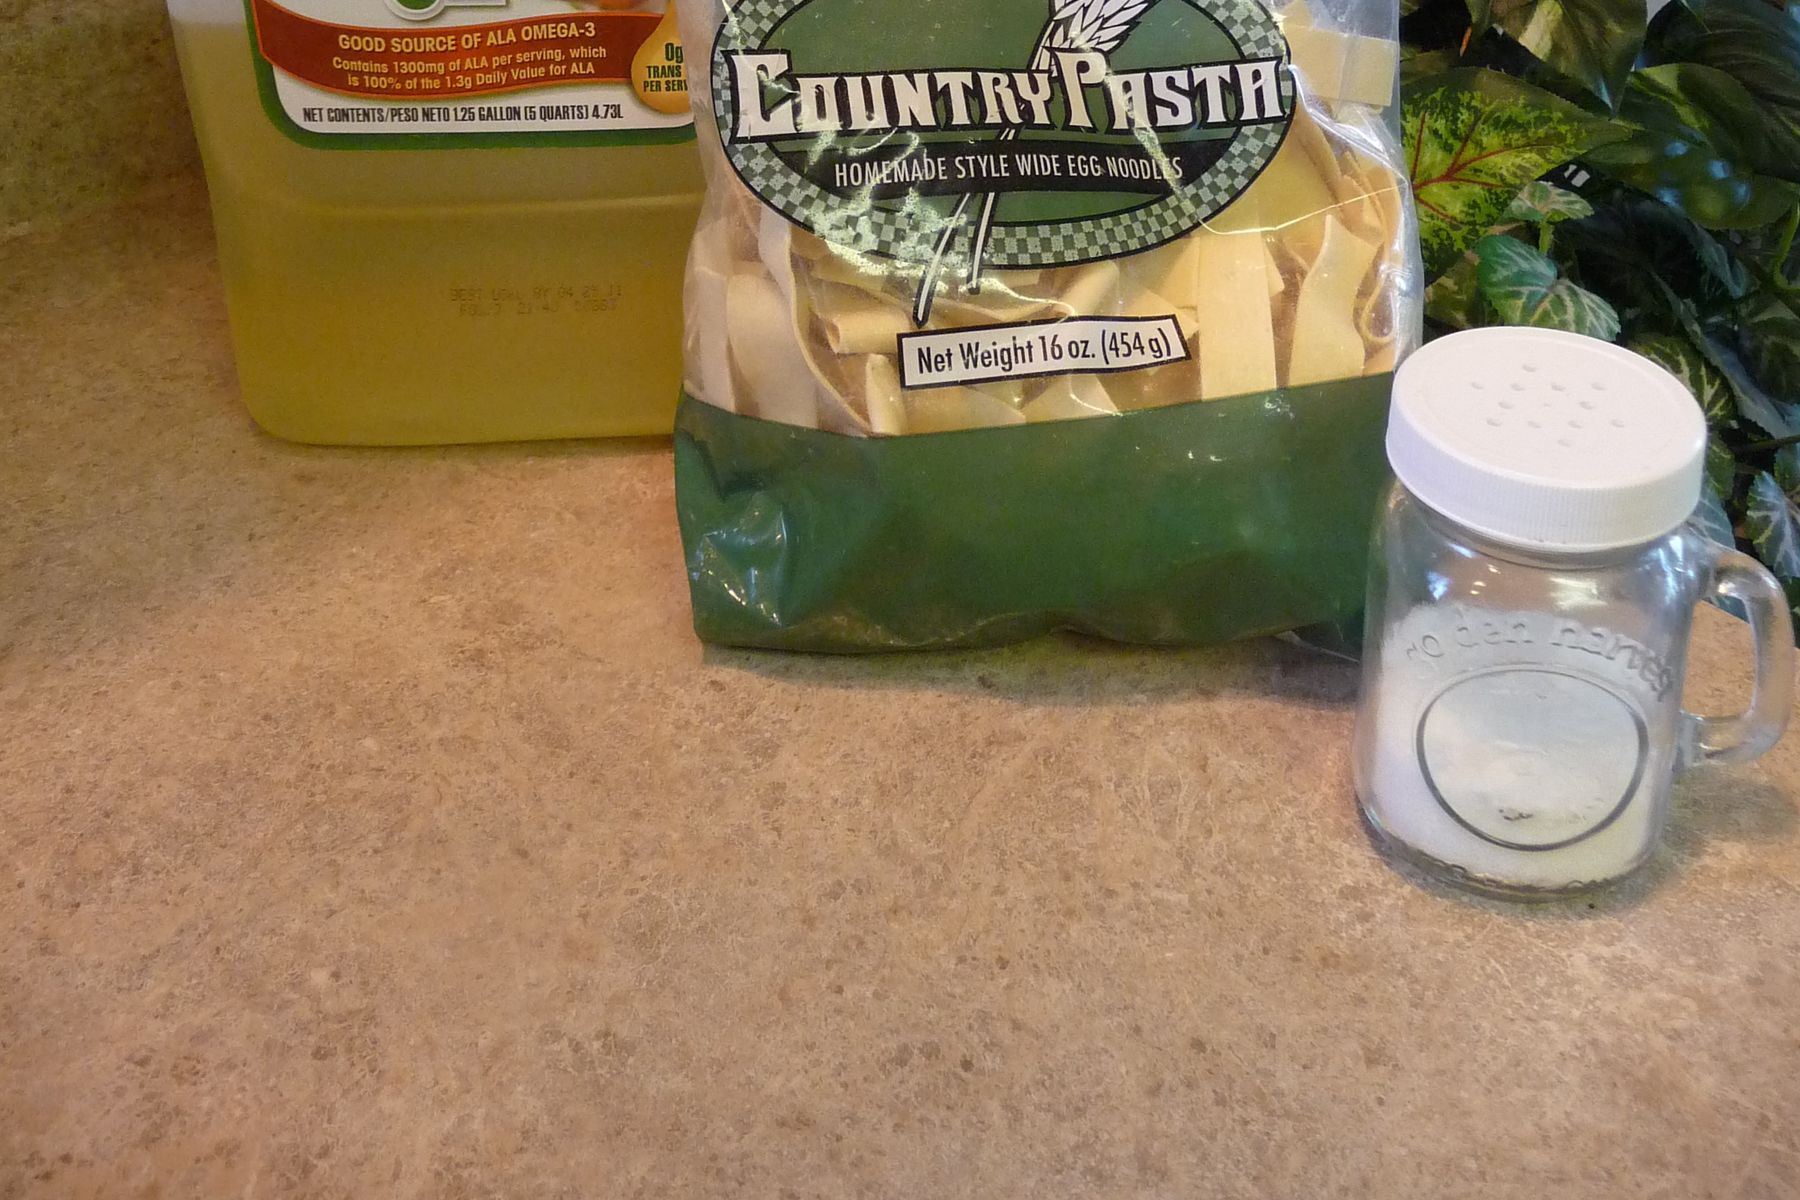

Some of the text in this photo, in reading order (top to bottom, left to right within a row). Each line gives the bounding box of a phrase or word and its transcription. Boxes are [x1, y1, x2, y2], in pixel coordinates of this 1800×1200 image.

[338, 21, 596, 53] GOOD SOURCE OF ALA OMEGA-3
[332, 46, 607, 75] Contains 1300mg of ALA per serving, which
[664, 42, 684, 64] 0g
[363, 75, 402, 89] 100%
[405, 77, 418, 90] of
[421, 76, 441, 89] the
[446, 75, 472, 89] 1.3g
[475, 70, 508, 86] Daily
[511, 65, 546, 81] Value
[549, 64, 567, 76] for
[570, 62, 595, 75] ALA
[643, 80, 662, 92] PER
[646, 65, 682, 79] TRANS
[730, 50, 1285, 139] COUNTRY PASTA
[302, 107, 324, 123] NET
[327, 107, 419, 123] CONTENTS/PESO
[421, 107, 450, 123] NETO
[452, 106, 476, 122] 1.25
[478, 106, 521, 122] GALLON
[592, 103, 624, 120] 4.73L
[834, 156, 948, 187] HOMEMADE
[954, 154, 1010, 179] STYLE
[1015, 154, 1062, 177] WIDE
[1068, 154, 1101, 177] EGG
[917, 327, 1172, 375] Net Weight 16 oz. (454 g)
